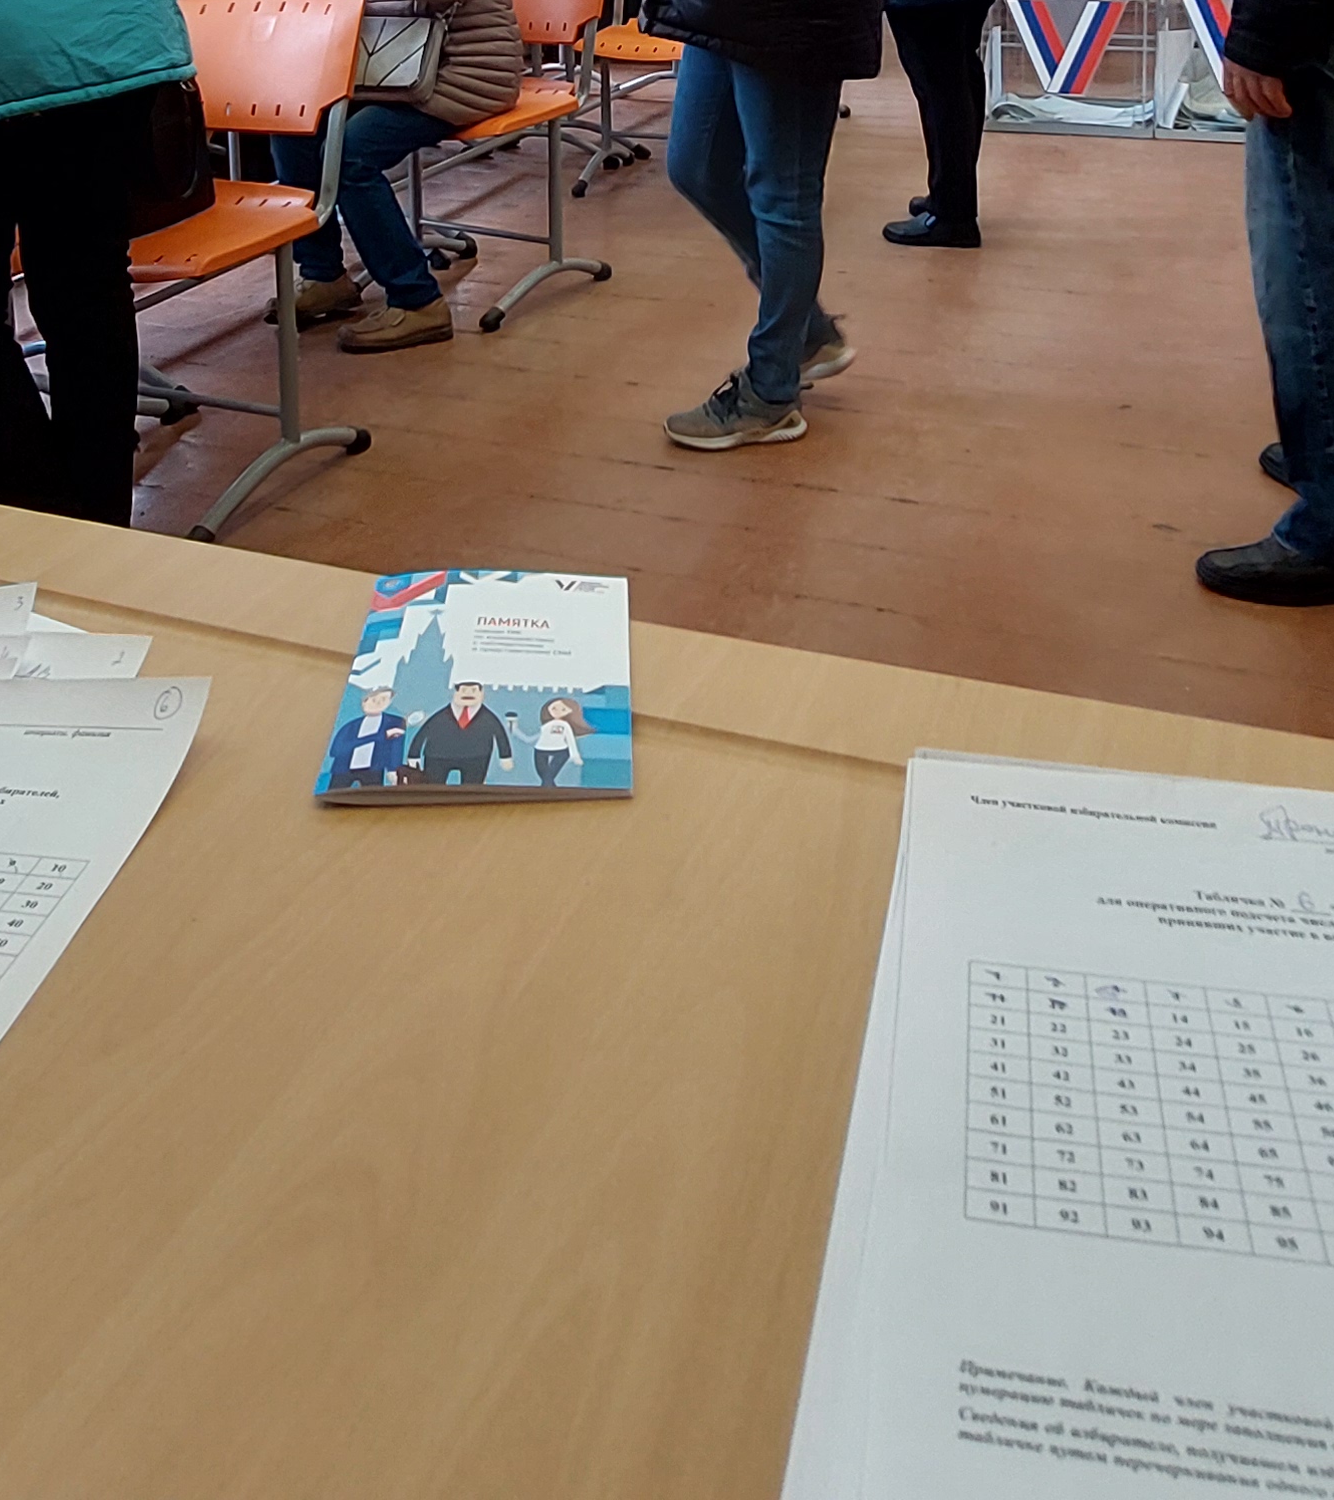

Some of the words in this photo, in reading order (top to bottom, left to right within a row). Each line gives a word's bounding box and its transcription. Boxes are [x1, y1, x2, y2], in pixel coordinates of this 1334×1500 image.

[477, 616, 550, 629] ПАМЯТКА
[50, 863, 67, 874] 10
[35, 881, 54, 891] 20
[20, 899, 39, 909] 30
[6, 918, 25, 928] 40
